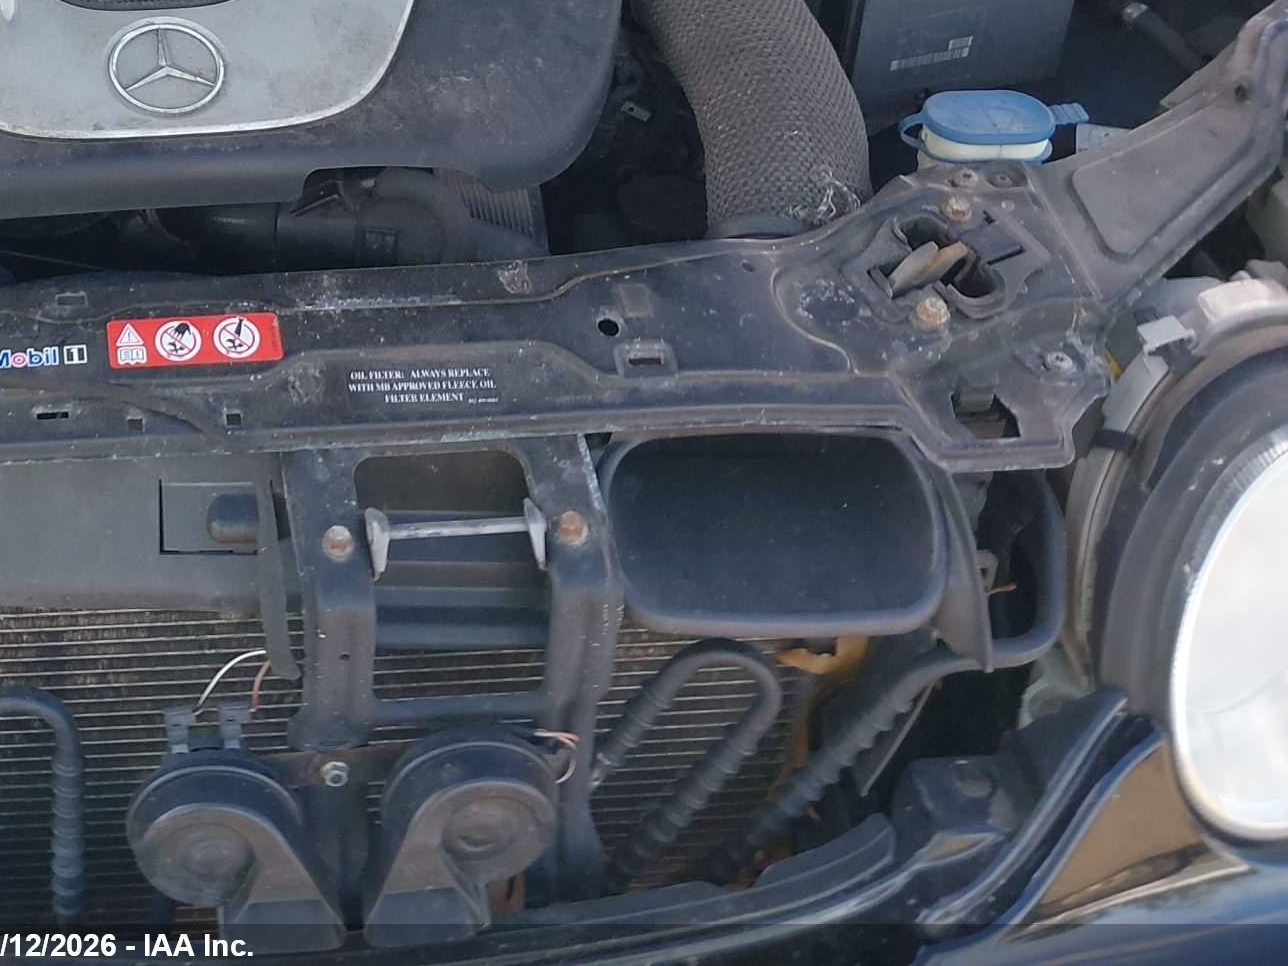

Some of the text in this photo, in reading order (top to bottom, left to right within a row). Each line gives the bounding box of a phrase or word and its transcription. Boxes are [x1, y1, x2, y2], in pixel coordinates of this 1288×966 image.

[65, 345, 86, 364] 1
[350, 368, 489, 380] OIL FILTER: ALWAYS REPLACE
[348, 379, 496, 393] WITH MB APPROVED FLEECE OIL
[384, 393, 418, 403] FILTER
[419, 392, 464, 402] ELEMENT
